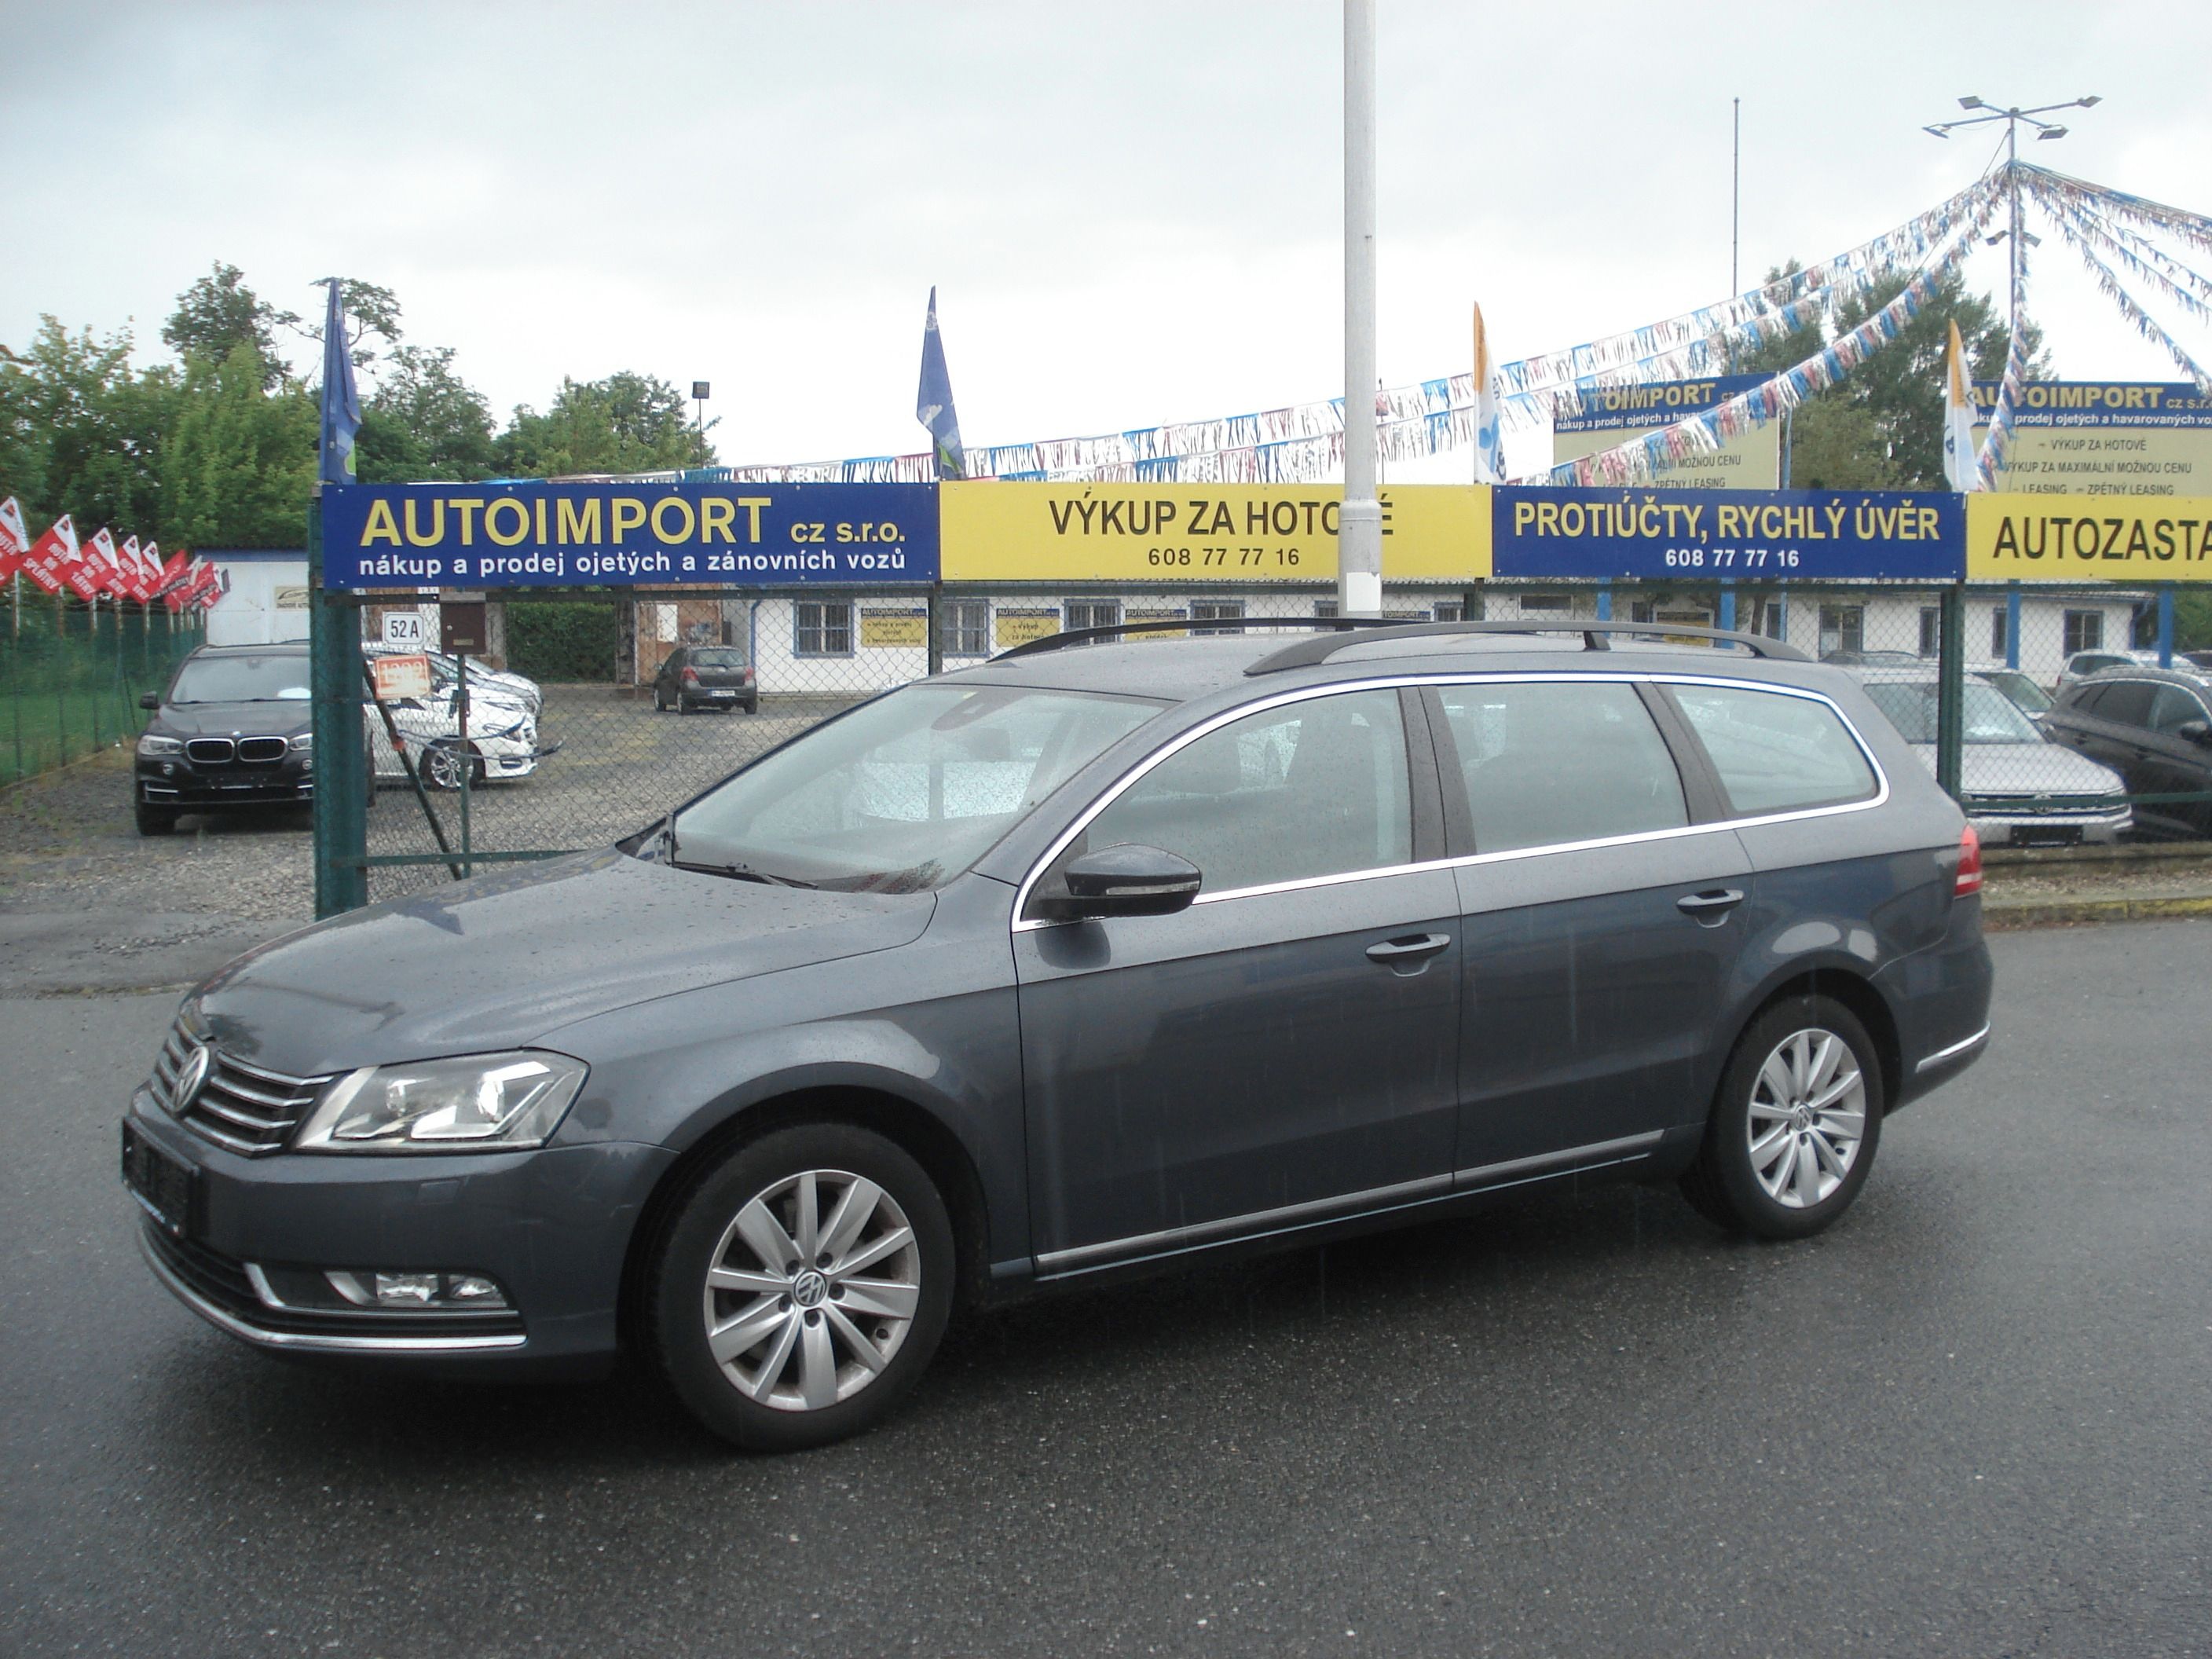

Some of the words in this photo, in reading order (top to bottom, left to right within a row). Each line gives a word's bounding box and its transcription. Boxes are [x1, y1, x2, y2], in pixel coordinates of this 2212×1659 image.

[2166, 398, 2184, 409] cz
[1595, 416, 1624, 430] prodej
[1626, 413, 1661, 427] ojetých
[2014, 413, 2053, 427] prodej
[2055, 413, 2099, 427] ojetých
[2101, 416, 2109, 424] a
[2112, 413, 2195, 427] havarovaných
[2088, 439, 2101, 451] ZA
[1718, 455, 1741, 467] CENU
[2041, 461, 2055, 473] ZA
[2164, 462, 2192, 474] CENU
[2023, 483, 2067, 495] LEASING
[2130, 484, 2174, 496] LEASING
[359, 496, 771, 548] AUTOIMPORT
[789, 522, 826, 543] cz
[836, 522, 906, 543] s.r.o.
[1049, 493, 1177, 536] VÝKUP
[1188, 500, 1236, 536] ZA
[1247, 493, 1394, 536] HOTOÉ
[1514, 496, 1708, 544] PROTIÚČTY,
[1718, 495, 1848, 540] RYCHLÝ
[1855, 498, 1939, 540] ÚVĚR
[359, 555, 442, 578] nákup
[452, 558, 468, 575] a
[480, 552, 565, 577] prodej
[575, 551, 671, 577] ojetých
[682, 556, 696, 572] a
[707, 549, 836, 571] zánovních
[846, 548, 906, 569] vozů
[1148, 548, 1192, 566] 608
[1202, 548, 1227, 566] 77
[1239, 548, 1264, 566] 77
[1276, 548, 1300, 566] 16
[1665, 549, 1705, 567] 608
[1712, 549, 1736, 567] 77
[1745, 549, 1767, 567] 77
[1777, 549, 1800, 567] 16
[390, 620, 407, 639] 52
[410, 620, 419, 639] A
